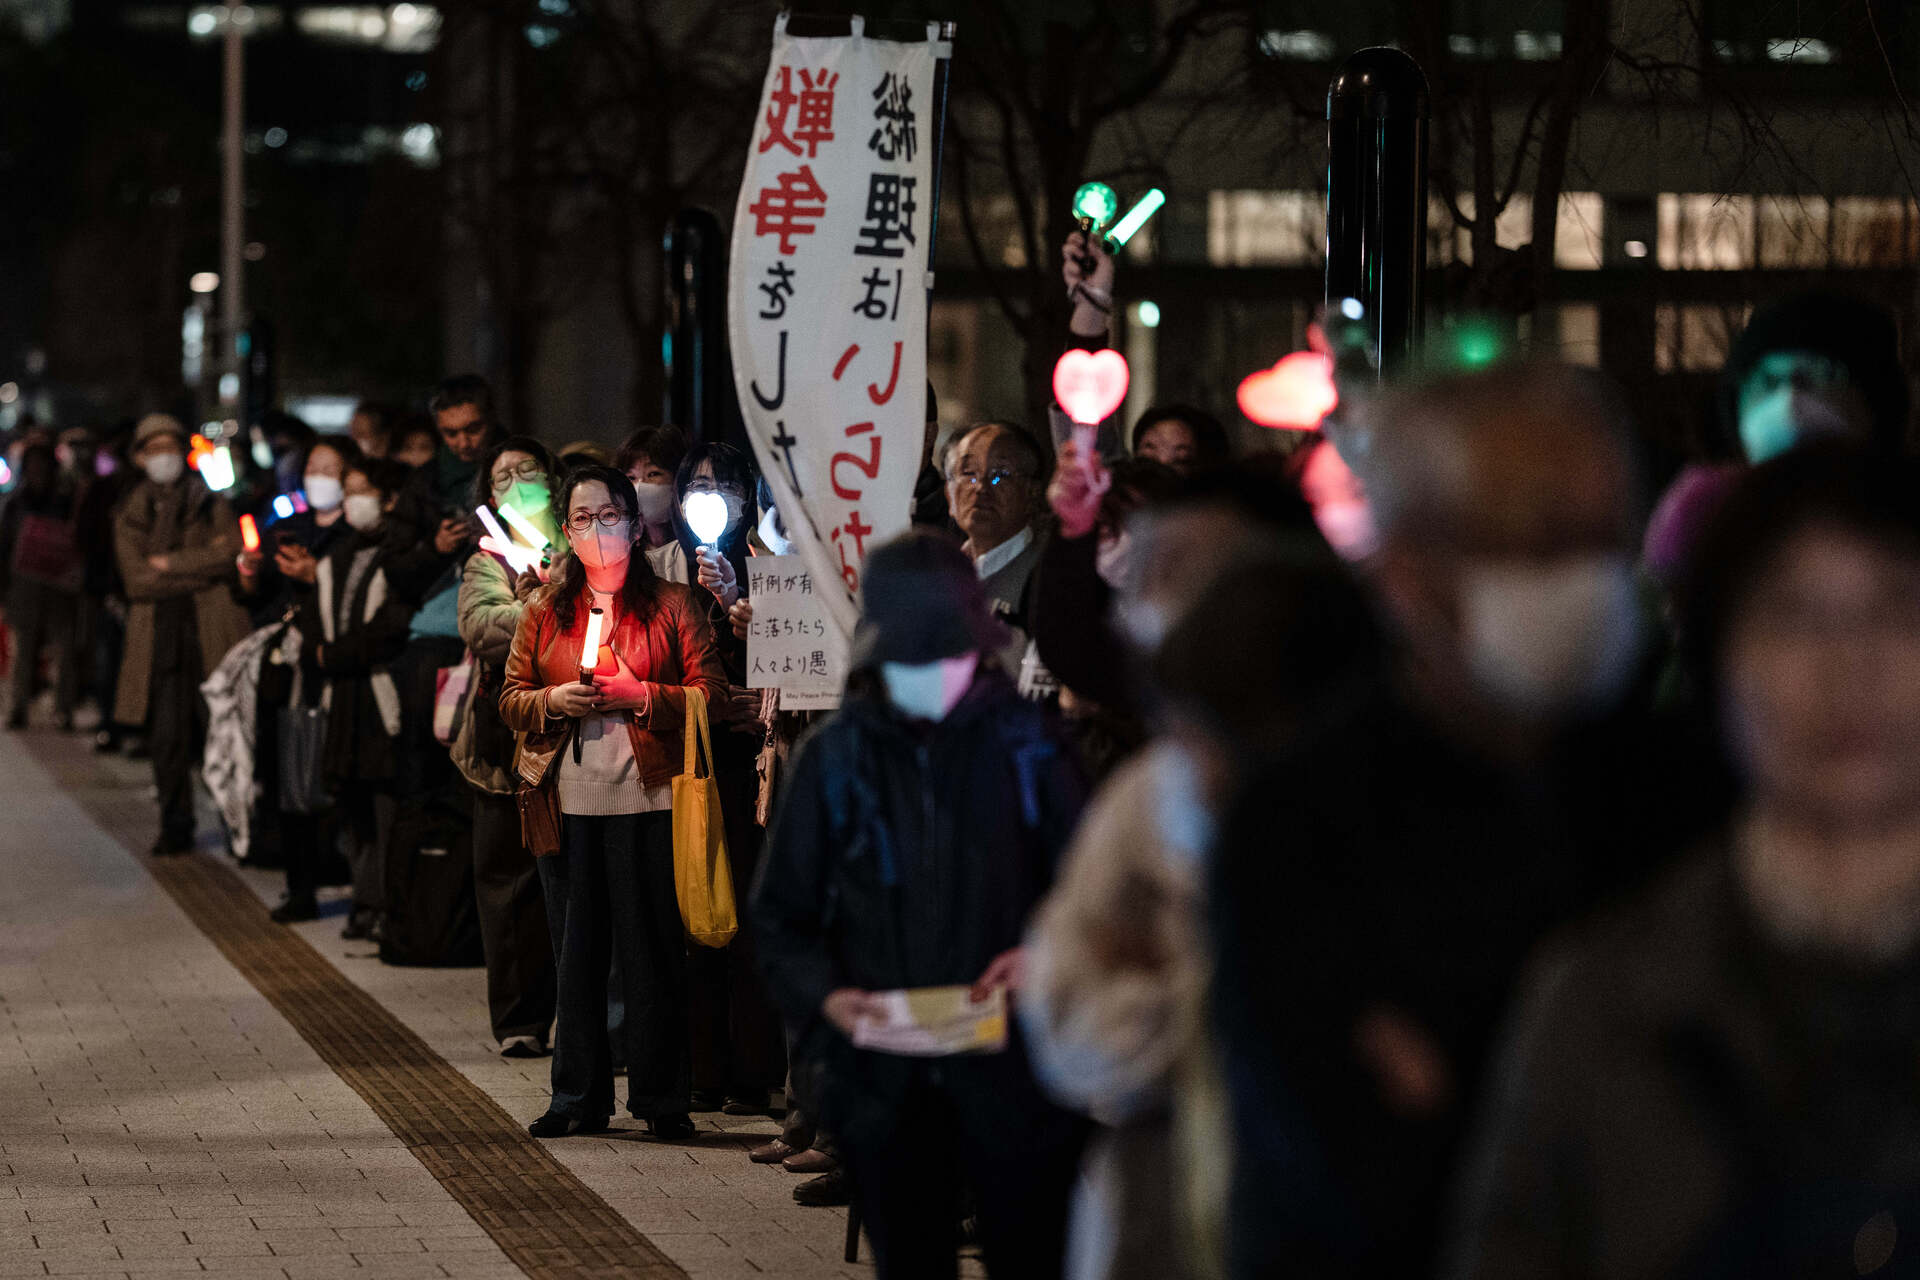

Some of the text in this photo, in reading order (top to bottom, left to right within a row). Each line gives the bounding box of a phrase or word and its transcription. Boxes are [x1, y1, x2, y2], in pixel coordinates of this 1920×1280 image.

[751, 571, 813, 595] 前例が有
[750, 617, 825, 639] に落ちたら
[751, 650, 828, 677] 人々より愚
